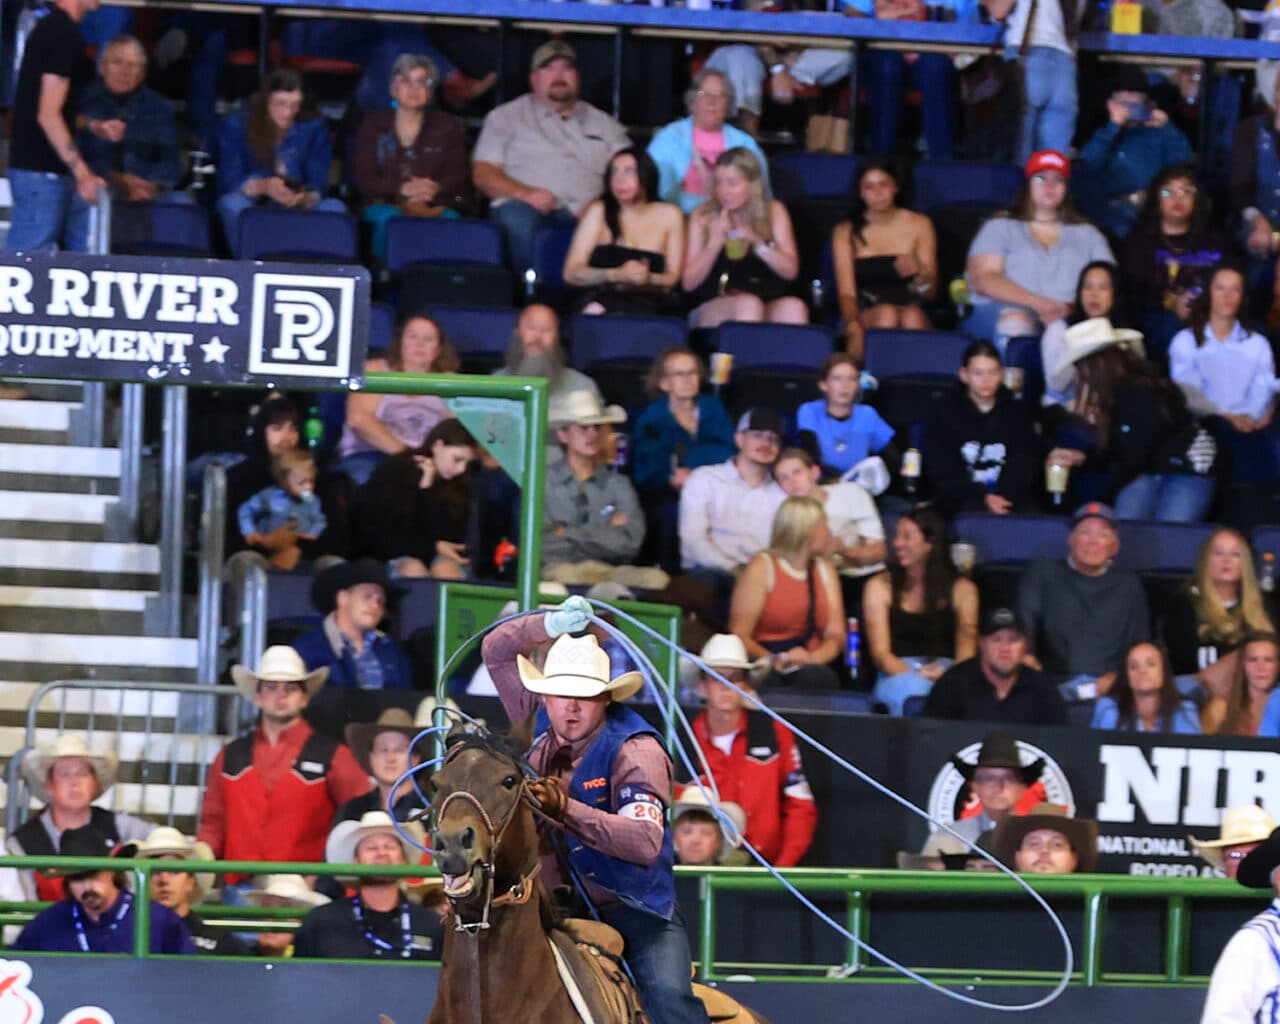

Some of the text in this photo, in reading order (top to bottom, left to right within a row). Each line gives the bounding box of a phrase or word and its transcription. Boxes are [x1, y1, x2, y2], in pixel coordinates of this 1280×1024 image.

[46, 268, 240, 325] RIVER
[1097, 835, 1190, 856] NATIONAL
[1130, 862, 1198, 877] RODEO
